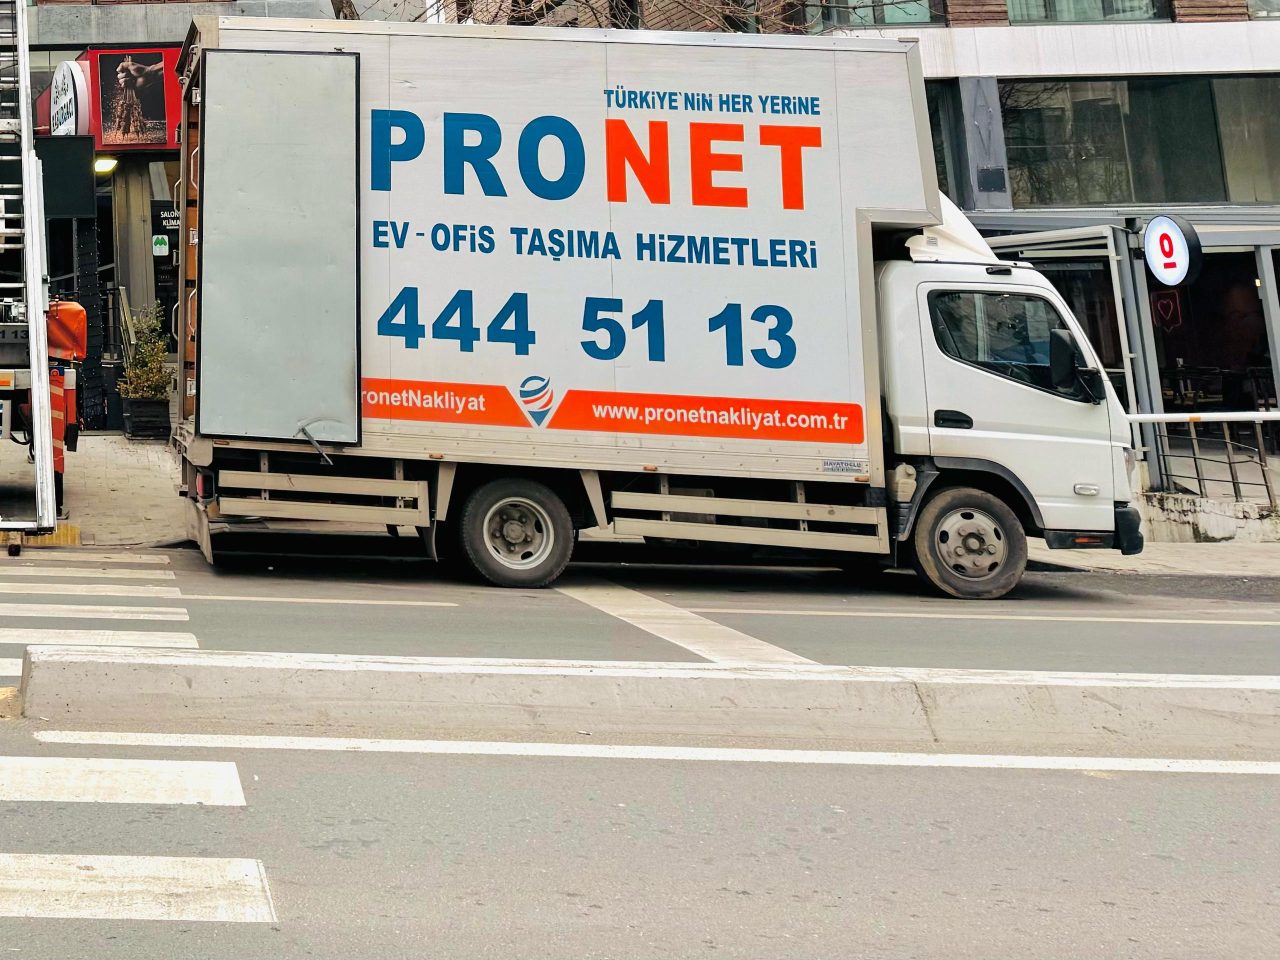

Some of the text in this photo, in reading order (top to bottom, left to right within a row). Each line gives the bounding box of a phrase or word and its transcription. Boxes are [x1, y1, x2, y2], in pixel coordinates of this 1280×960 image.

[719, 94, 754, 113] HER
[370, 109, 822, 210] PRONET
[510, 227, 622, 262] TAŞIMA
[11, 329, 29, 339] 13
[377, 286, 797, 370] 444 51 13
[593, 405, 848, 430] www.pronetnakliyat.com.tr
